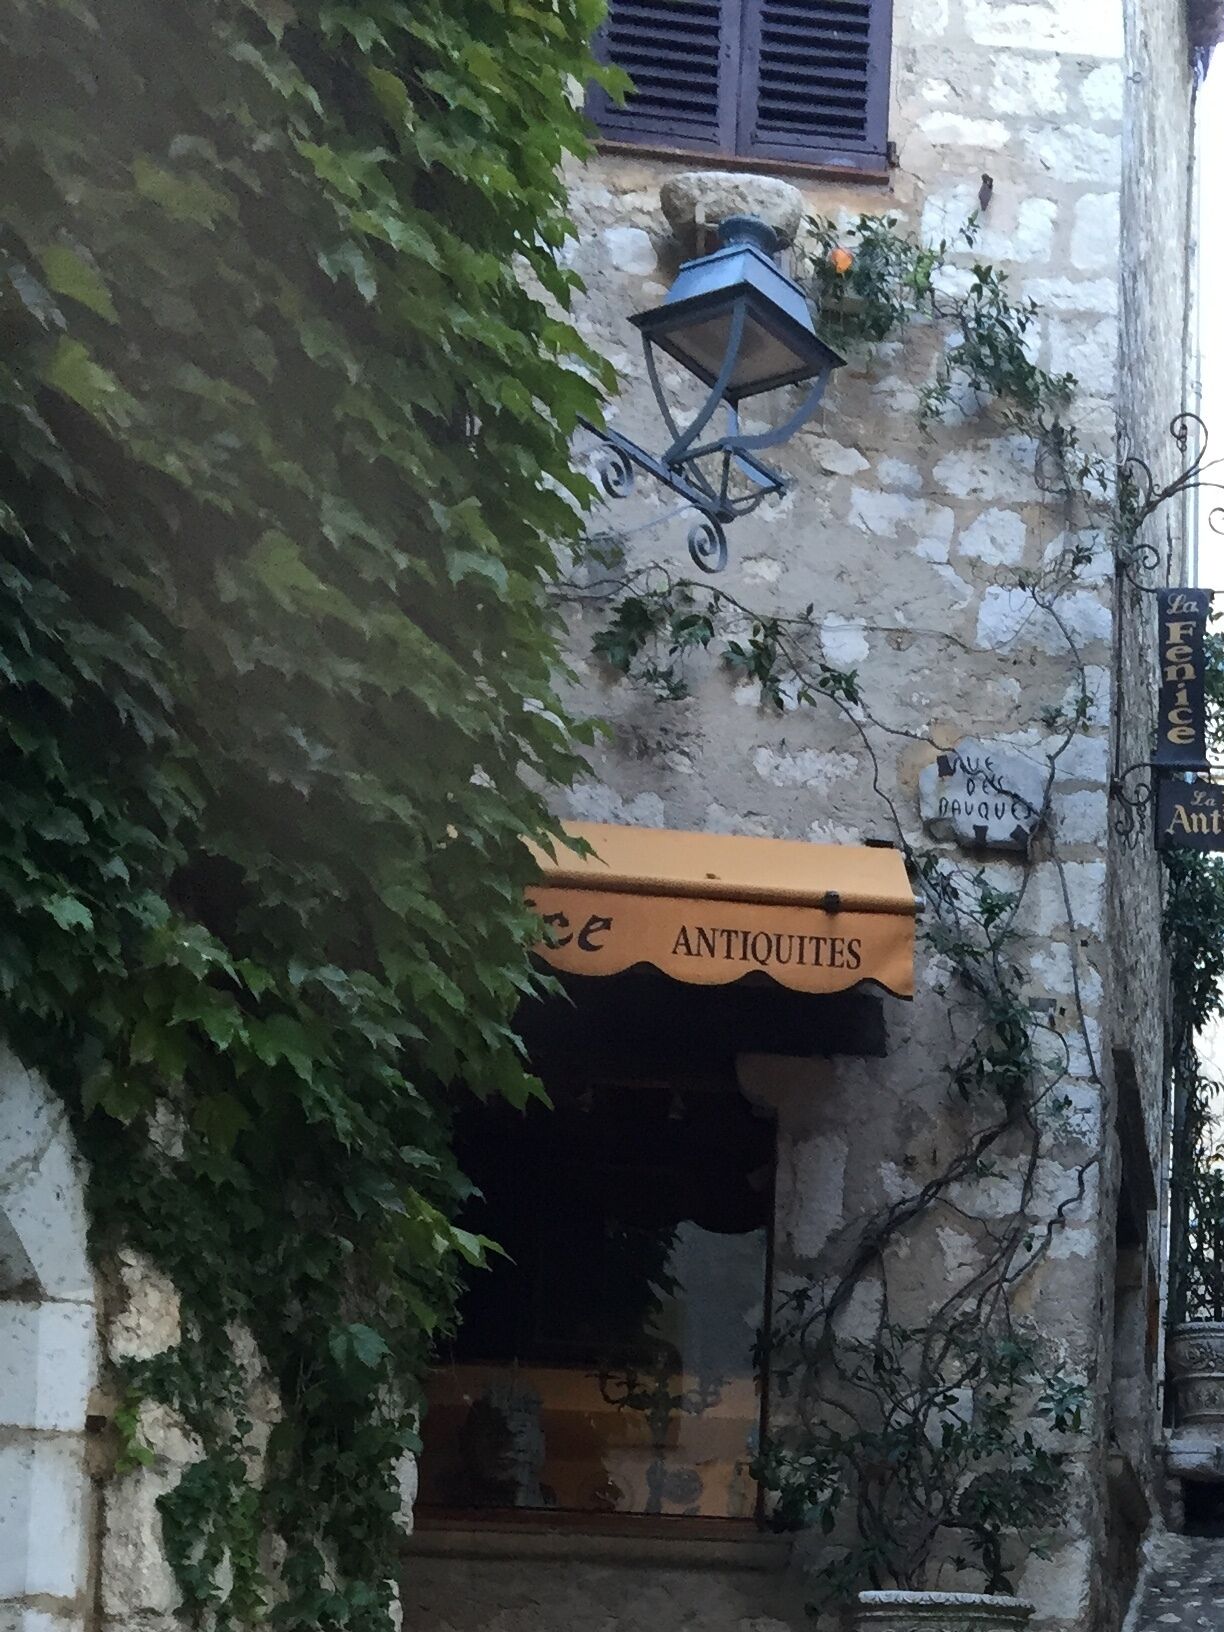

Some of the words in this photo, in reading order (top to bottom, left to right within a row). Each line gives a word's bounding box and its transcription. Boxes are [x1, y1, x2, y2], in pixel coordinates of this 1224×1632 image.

[1166, 593, 1199, 615] La
[1164, 621, 1197, 745] Fenice
[1190, 790, 1217, 807] La
[526, 902, 613, 952] ce
[671, 924, 862, 970] ANTIQUITES
